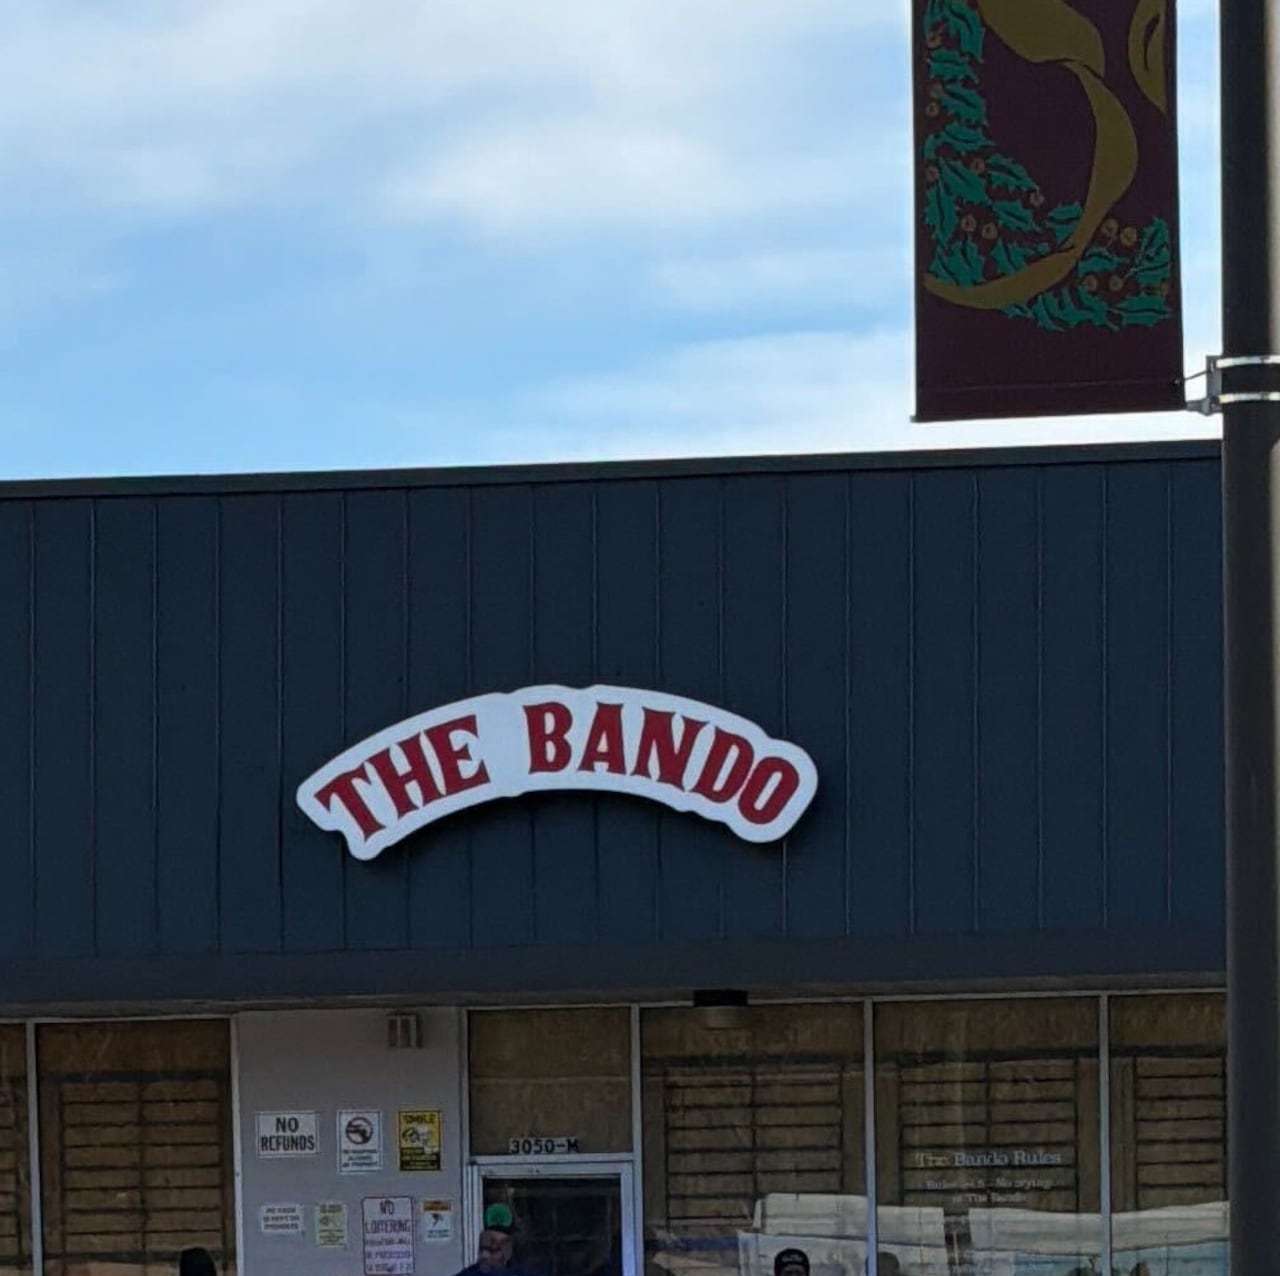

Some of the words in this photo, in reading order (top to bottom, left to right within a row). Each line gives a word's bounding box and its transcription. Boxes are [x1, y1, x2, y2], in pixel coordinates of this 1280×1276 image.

[314, 714, 490, 842] THE
[523, 701, 799, 825] BANDO
[275, 1117, 299, 1133] NO
[261, 1135, 315, 1151] REFUNDS
[954, 1151, 1008, 1166] Bando
[1013, 1150, 1061, 1166] Rules
[380, 1200, 395, 1215] NO
